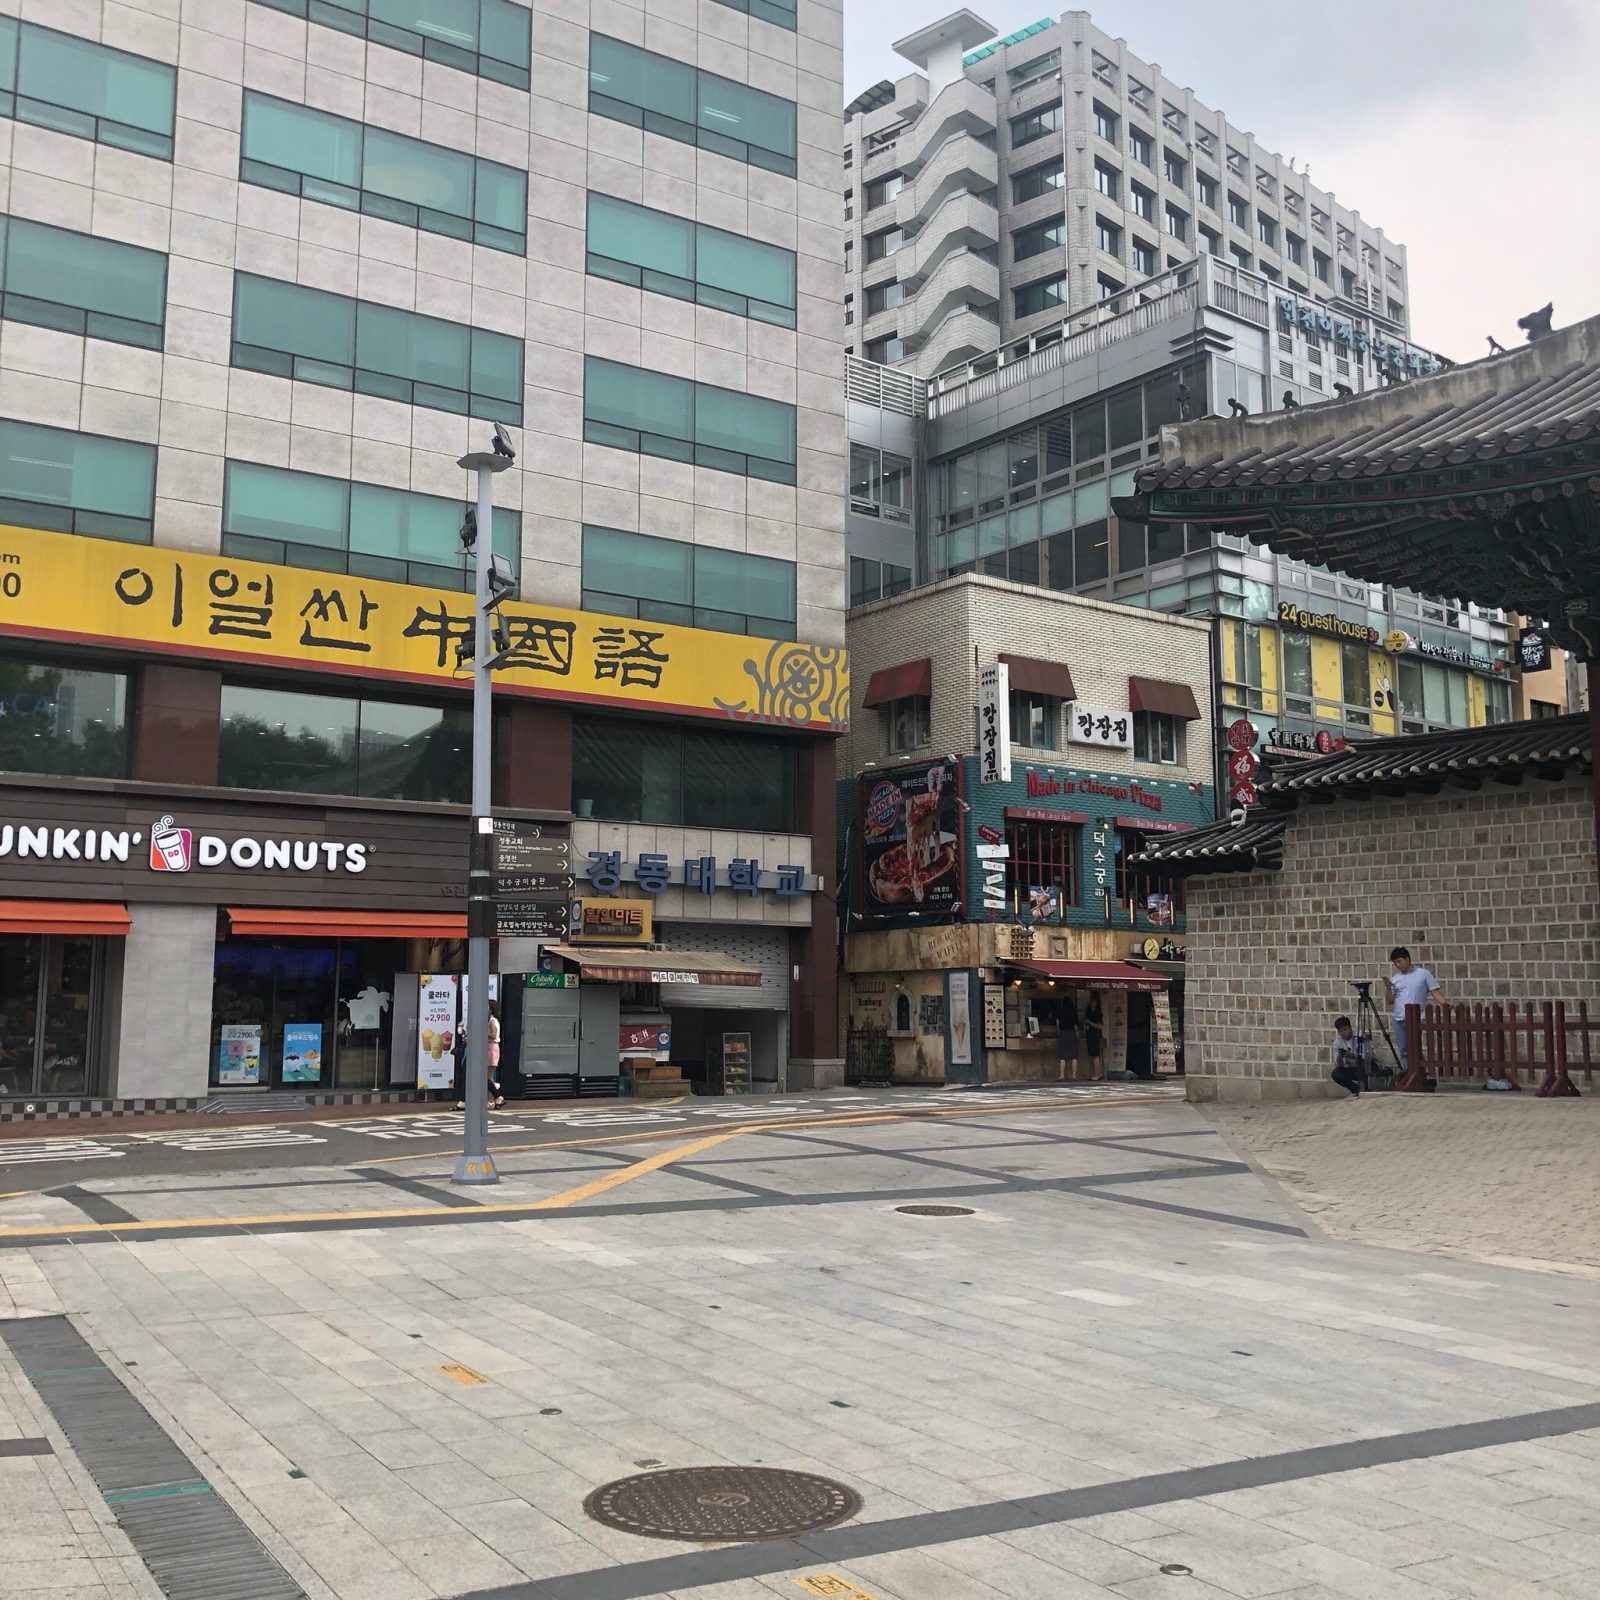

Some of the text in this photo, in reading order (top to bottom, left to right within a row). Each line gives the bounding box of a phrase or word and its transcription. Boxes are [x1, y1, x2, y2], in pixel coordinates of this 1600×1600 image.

[0, 553, 21, 565] m
[0, 572, 21, 598] 0
[115, 563, 379, 652] 이얼싼
[1281, 603, 1297, 622] 24
[1300, 611, 1368, 639] guesthouse
[1078, 713, 1127, 742] 깡장집
[868, 789, 902, 816] MADE IN
[871, 785, 894, 804] CHICAGO
[1026, 771, 1162, 812] Made in Chicago Pizza
[877, 808, 895, 822] PIZZA
[198, 836, 367, 873] DONUTS
[1093, 832, 1105, 884] 덕수궁
[586, 851, 808, 897] 경동대학교
[584, 907, 643, 925] 할인마트
[428, 991, 450, 999] 쿨라타
